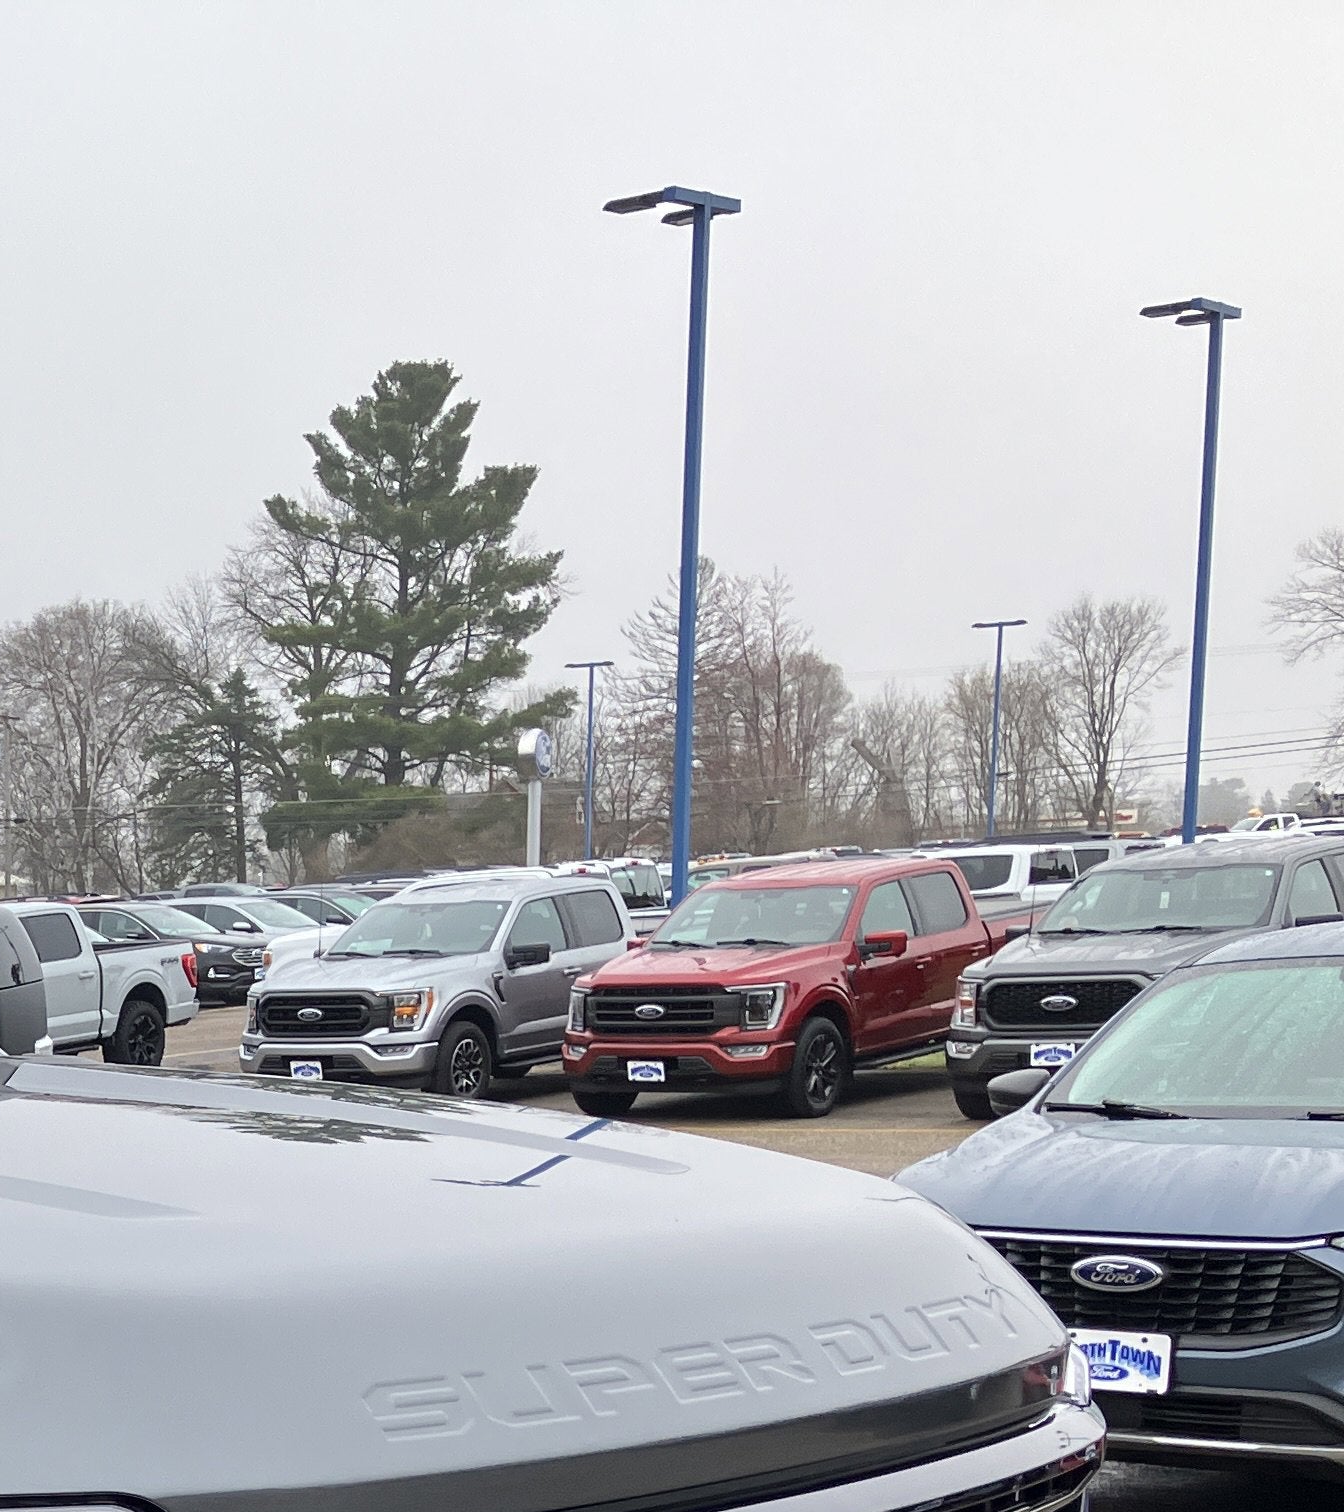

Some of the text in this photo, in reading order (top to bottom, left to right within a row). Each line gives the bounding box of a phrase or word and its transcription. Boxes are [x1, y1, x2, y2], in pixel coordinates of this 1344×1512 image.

[1091, 1262, 1141, 1285] Ford
[362, 1287, 1020, 1442] SUPER DUTY
[1090, 1365, 1121, 1379] Ford
[1108, 1339, 1162, 1378] TOWN
